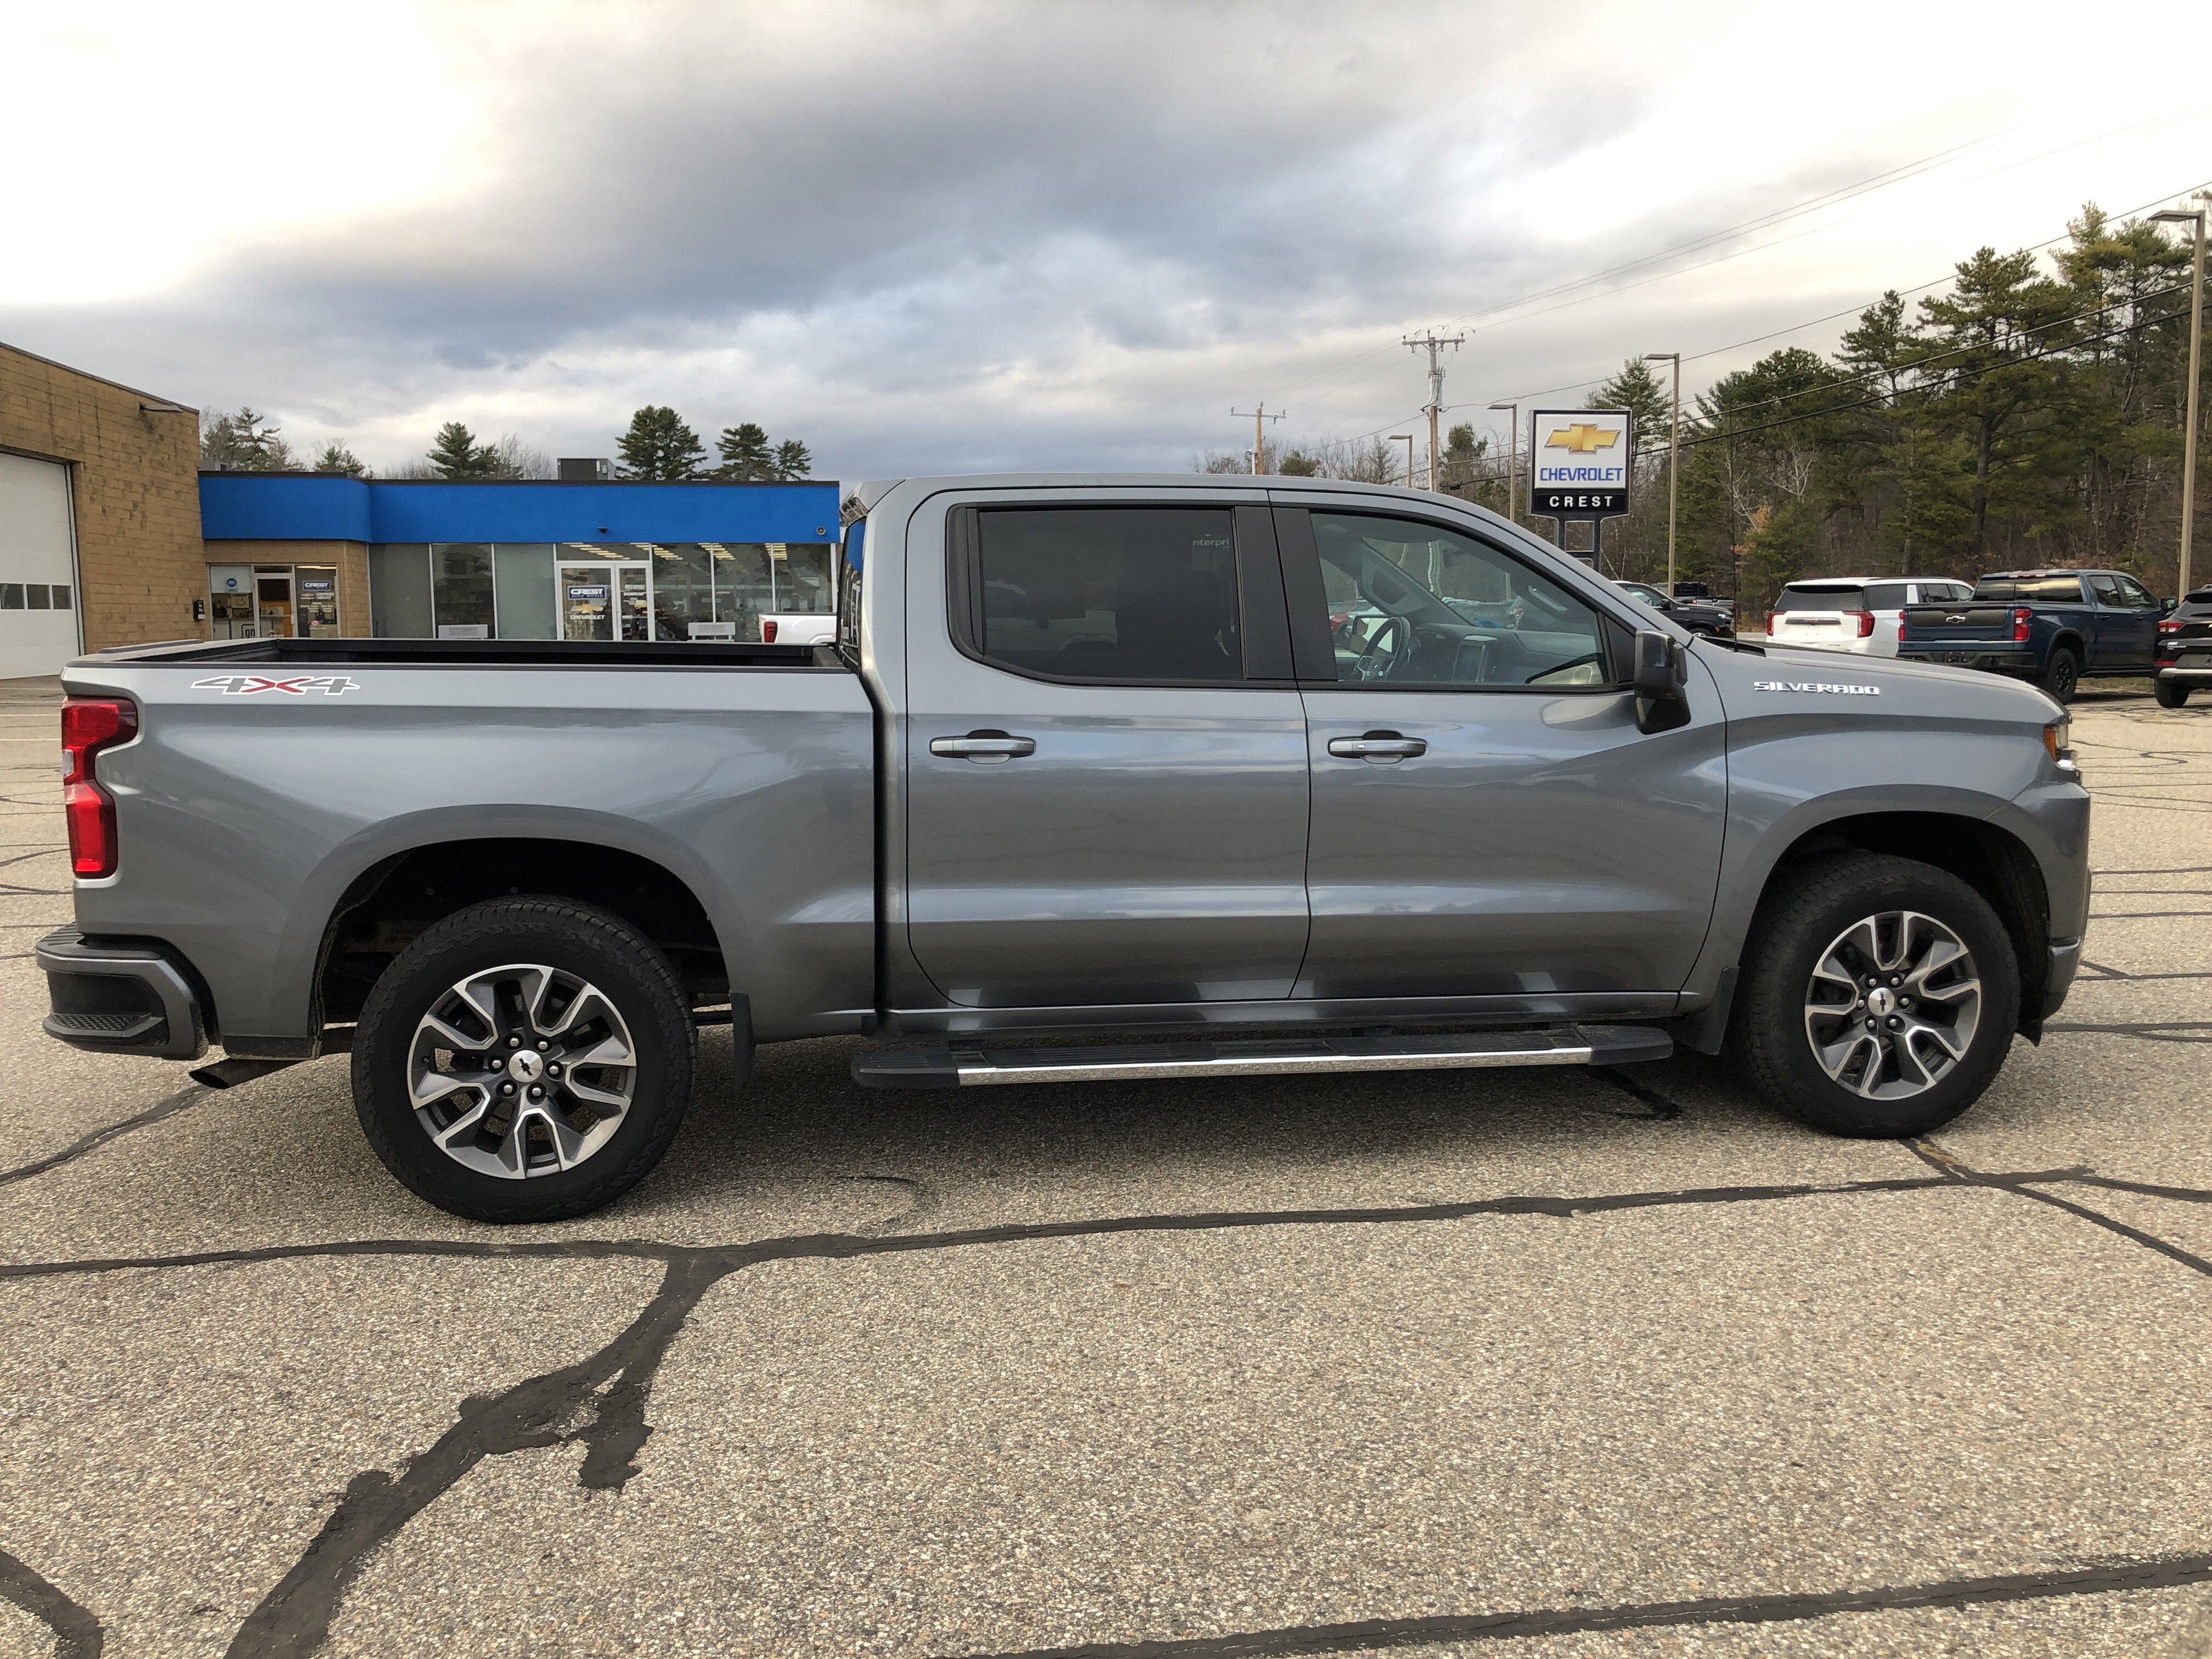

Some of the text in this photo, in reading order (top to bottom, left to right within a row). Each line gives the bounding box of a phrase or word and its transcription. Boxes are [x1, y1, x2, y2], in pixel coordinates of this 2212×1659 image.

[1540, 467, 1623, 481] CHEVROLET
[1549, 496, 1613, 507] CREST
[1753, 681, 1880, 696] SILVERADO
